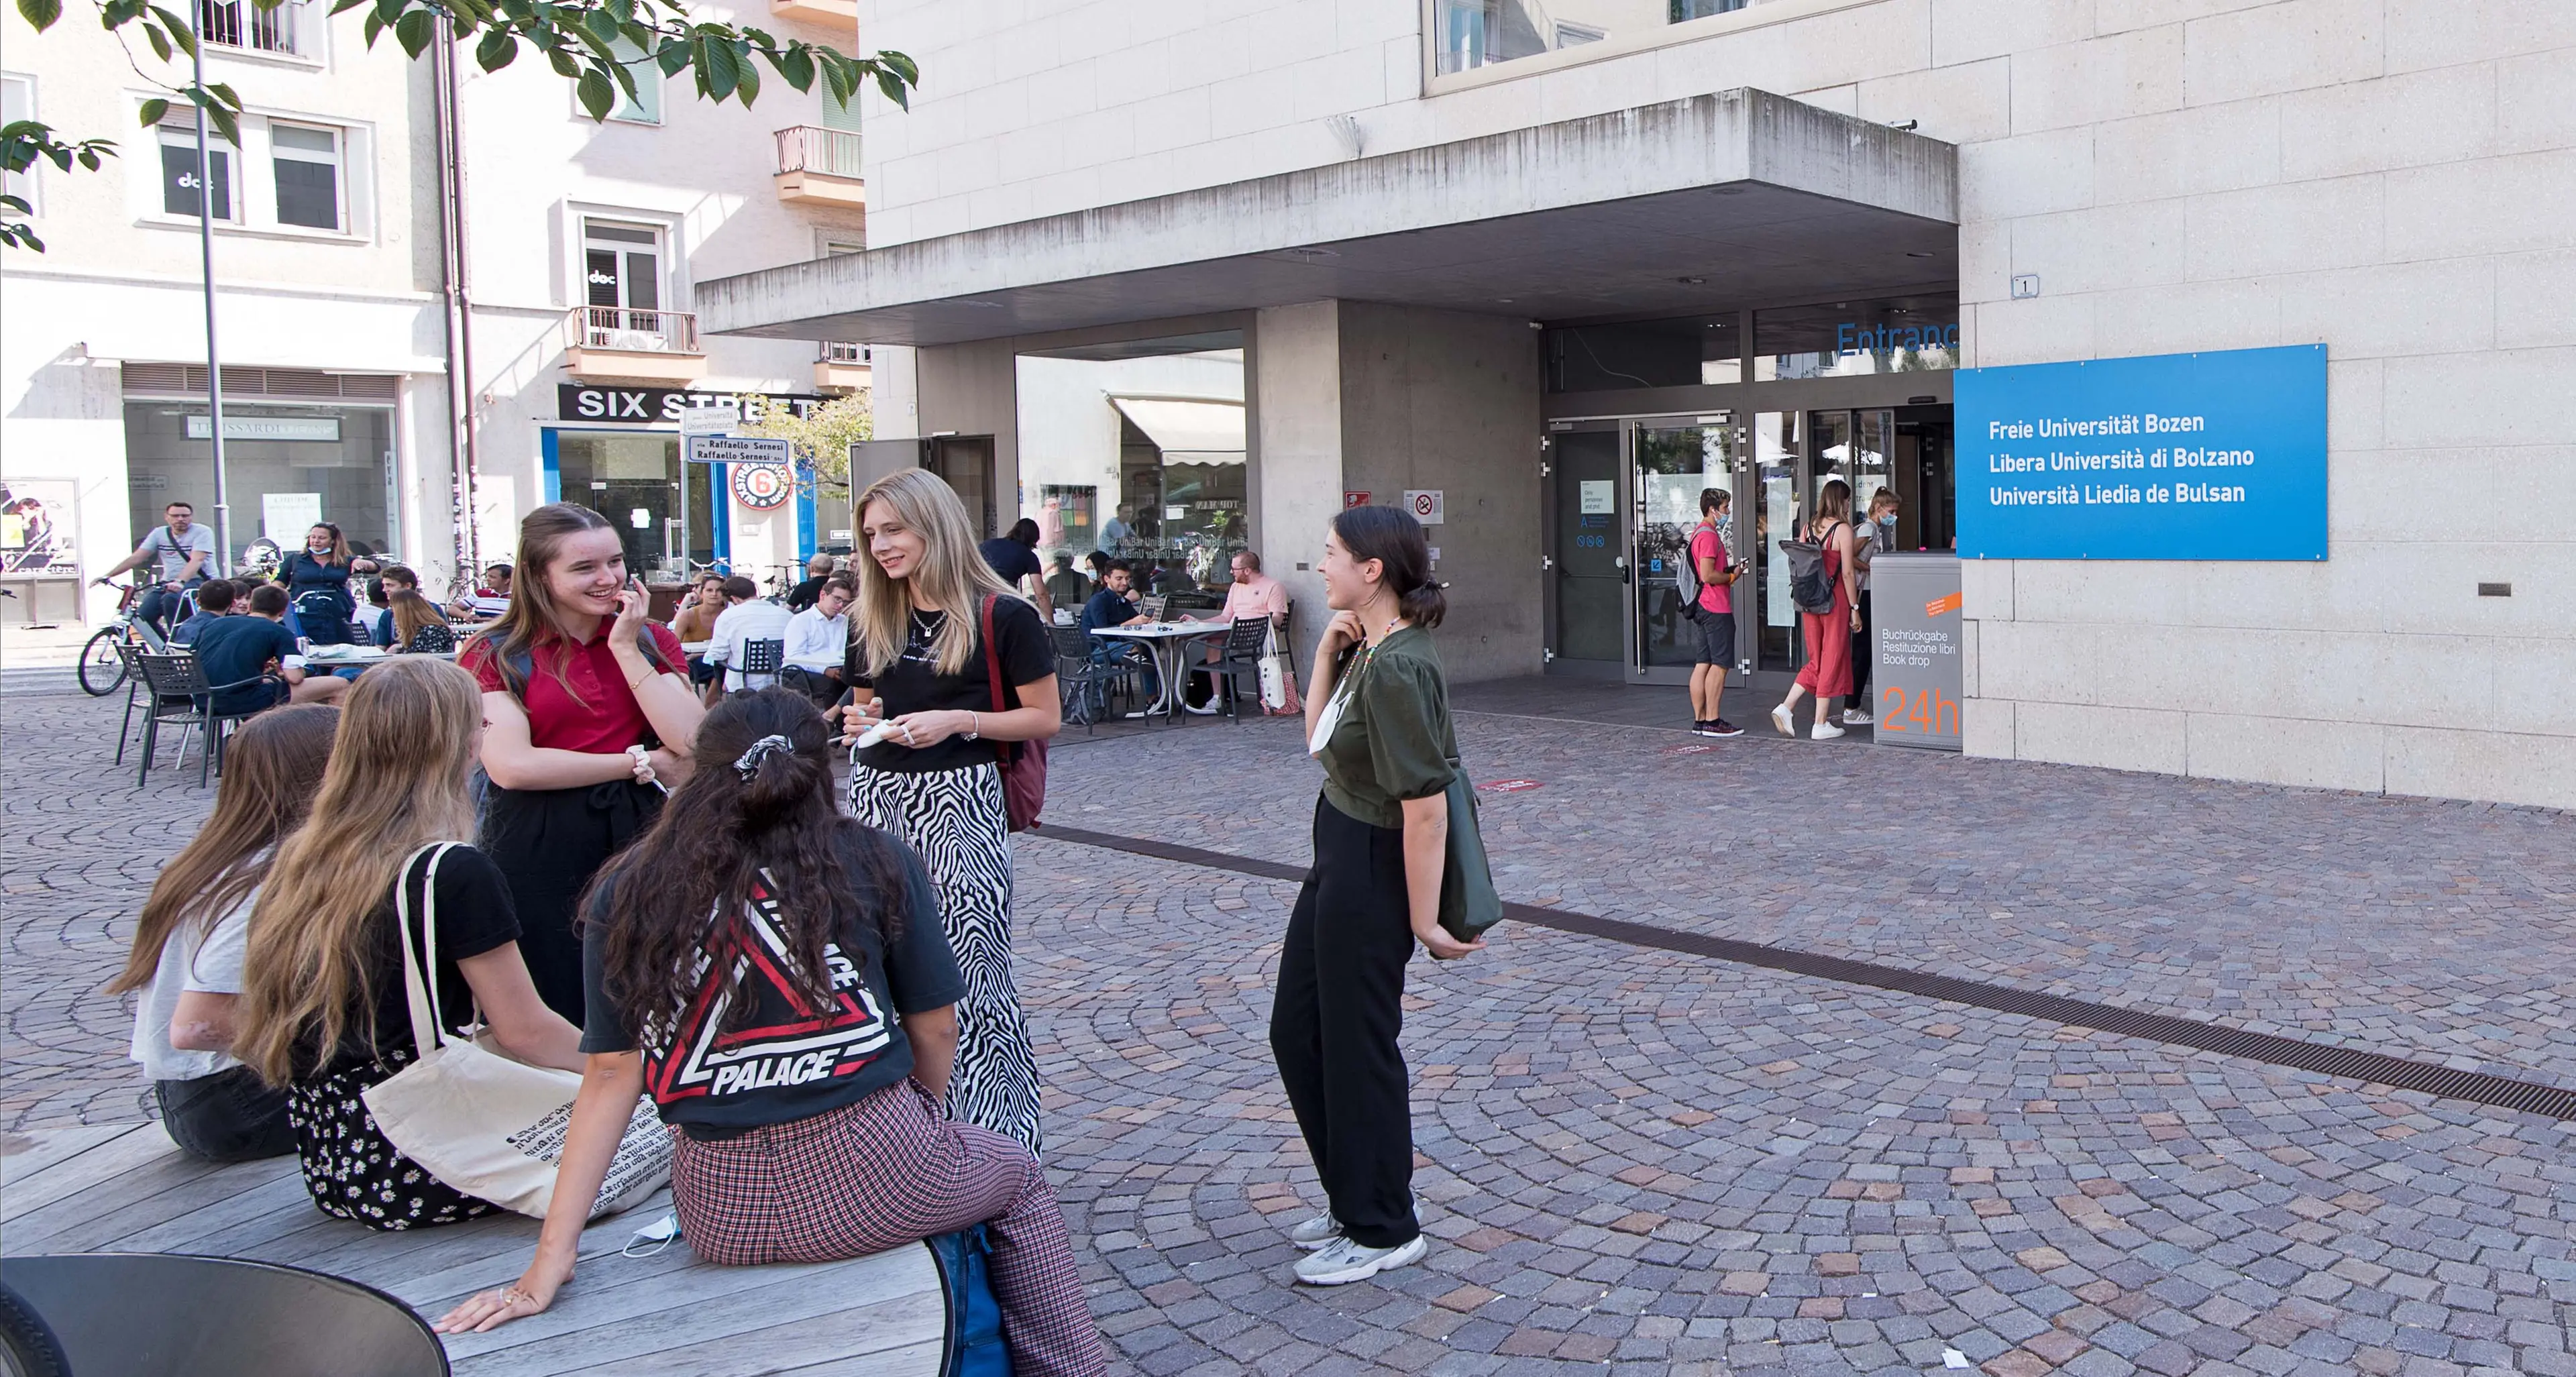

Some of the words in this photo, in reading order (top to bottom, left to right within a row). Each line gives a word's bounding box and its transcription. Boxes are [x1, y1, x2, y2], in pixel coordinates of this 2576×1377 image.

[588, 269, 616, 284] doc
[2023, 280, 2027, 292] 1
[1837, 323, 1960, 356] Entranc
[578, 390, 648, 418] SIX
[1989, 420, 2034, 440] Freie
[2039, 414, 2139, 437] Universität
[2145, 413, 2204, 433] Bozen
[709, 440, 749, 449] Raffaello
[753, 442, 784, 451] Sernesi
[1990, 453, 2045, 473] Libera
[2051, 448, 2144, 471] Università
[2150, 447, 2167, 468] di
[2174, 447, 2255, 467] Bolzano
[755, 472, 771, 494] 6
[1990, 484, 2079, 506] Università
[2085, 484, 2141, 504] Liedia
[2146, 483, 2169, 503] de
[2176, 482, 2245, 502] Bulsan
[1119, 537, 1144, 547] UniBar
[1145, 537, 1171, 547] UniBar
[1882, 628, 1948, 644] Buchrückgabe
[1882, 641, 1937, 654] Restituzione
[1939, 643, 1956, 655] libri
[1883, 653, 1907, 665] Book
[1908, 655, 1931, 669] drop
[1883, 686, 1959, 736] 24h
[711, 1047, 843, 1096] PALACE
